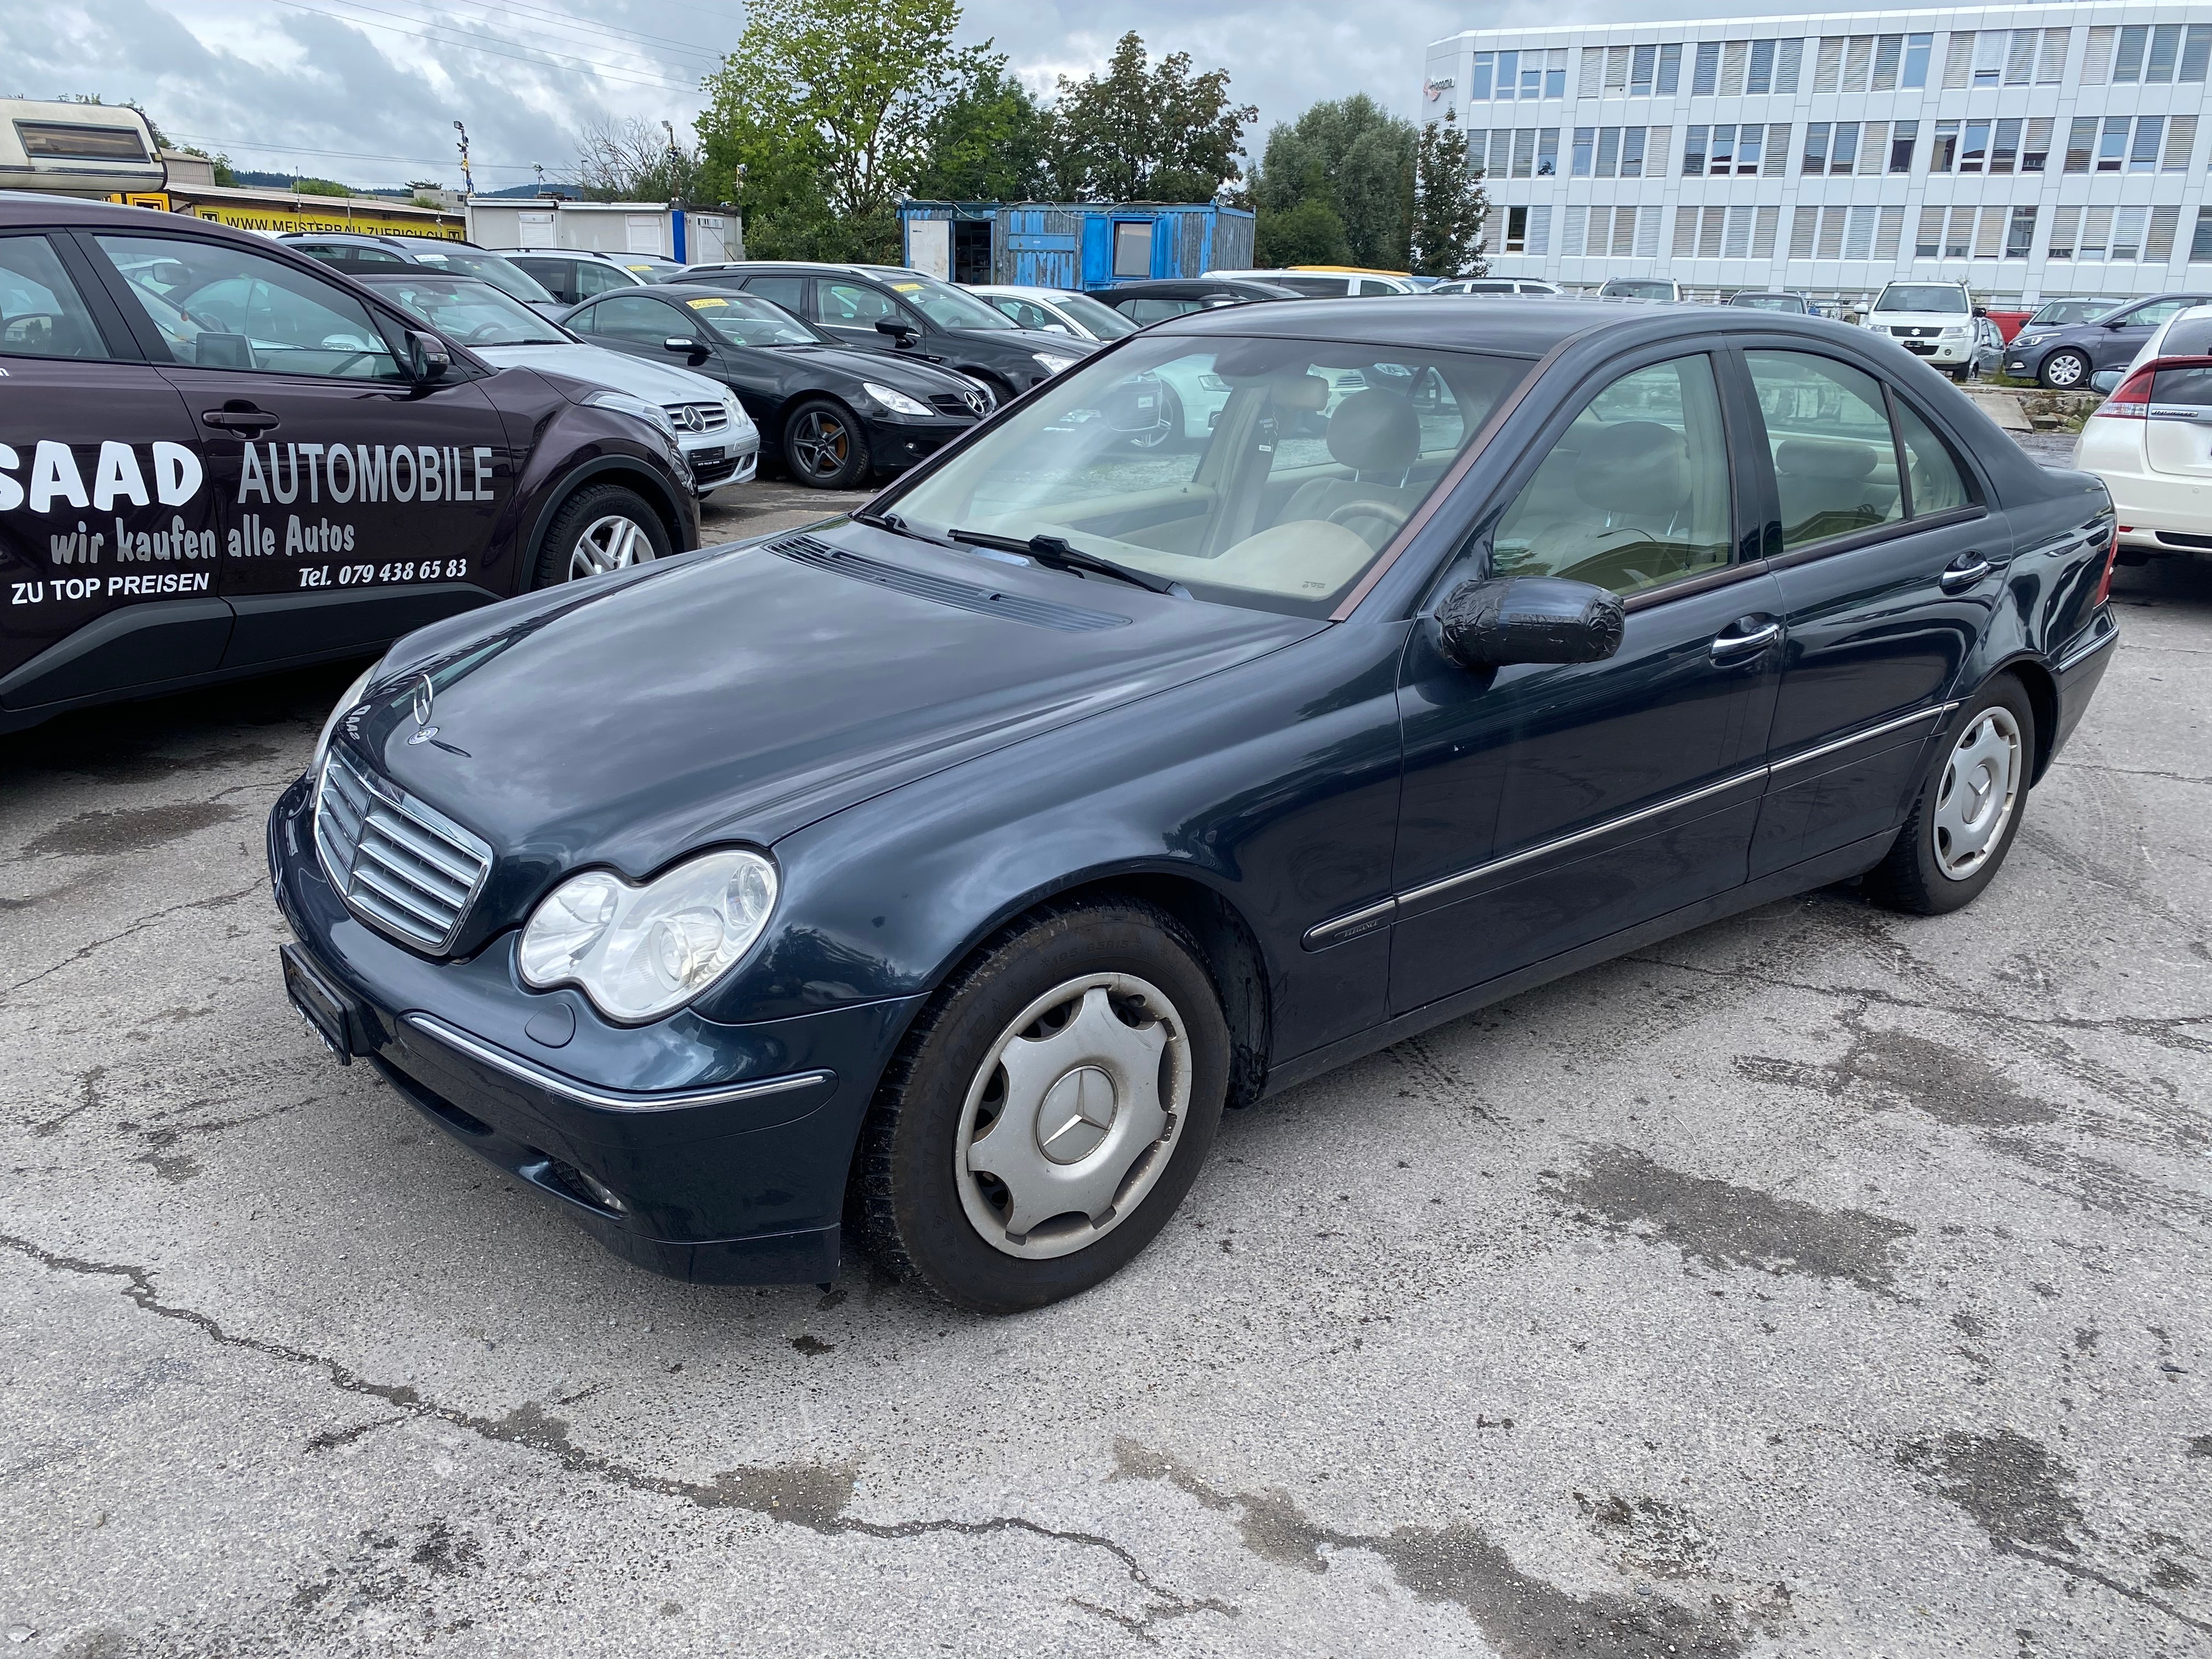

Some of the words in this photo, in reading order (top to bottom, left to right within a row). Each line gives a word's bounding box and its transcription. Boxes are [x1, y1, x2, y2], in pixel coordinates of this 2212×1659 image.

[238, 442, 494, 504] AUTOMOBILE
[50, 521, 104, 564] wir
[116, 515, 216, 562] kaufen
[228, 514, 275, 557] alle
[286, 515, 355, 556] Autos
[12, 581, 43, 605] ZU
[50, 578, 100, 601] TOP
[108, 572, 210, 596] PREISEN
[299, 566, 332, 587] Tel.
[338, 565, 374, 585] 079
[379, 562, 414, 582] 438
[420, 561, 441, 579] 65
[446, 558, 466, 578] 83
